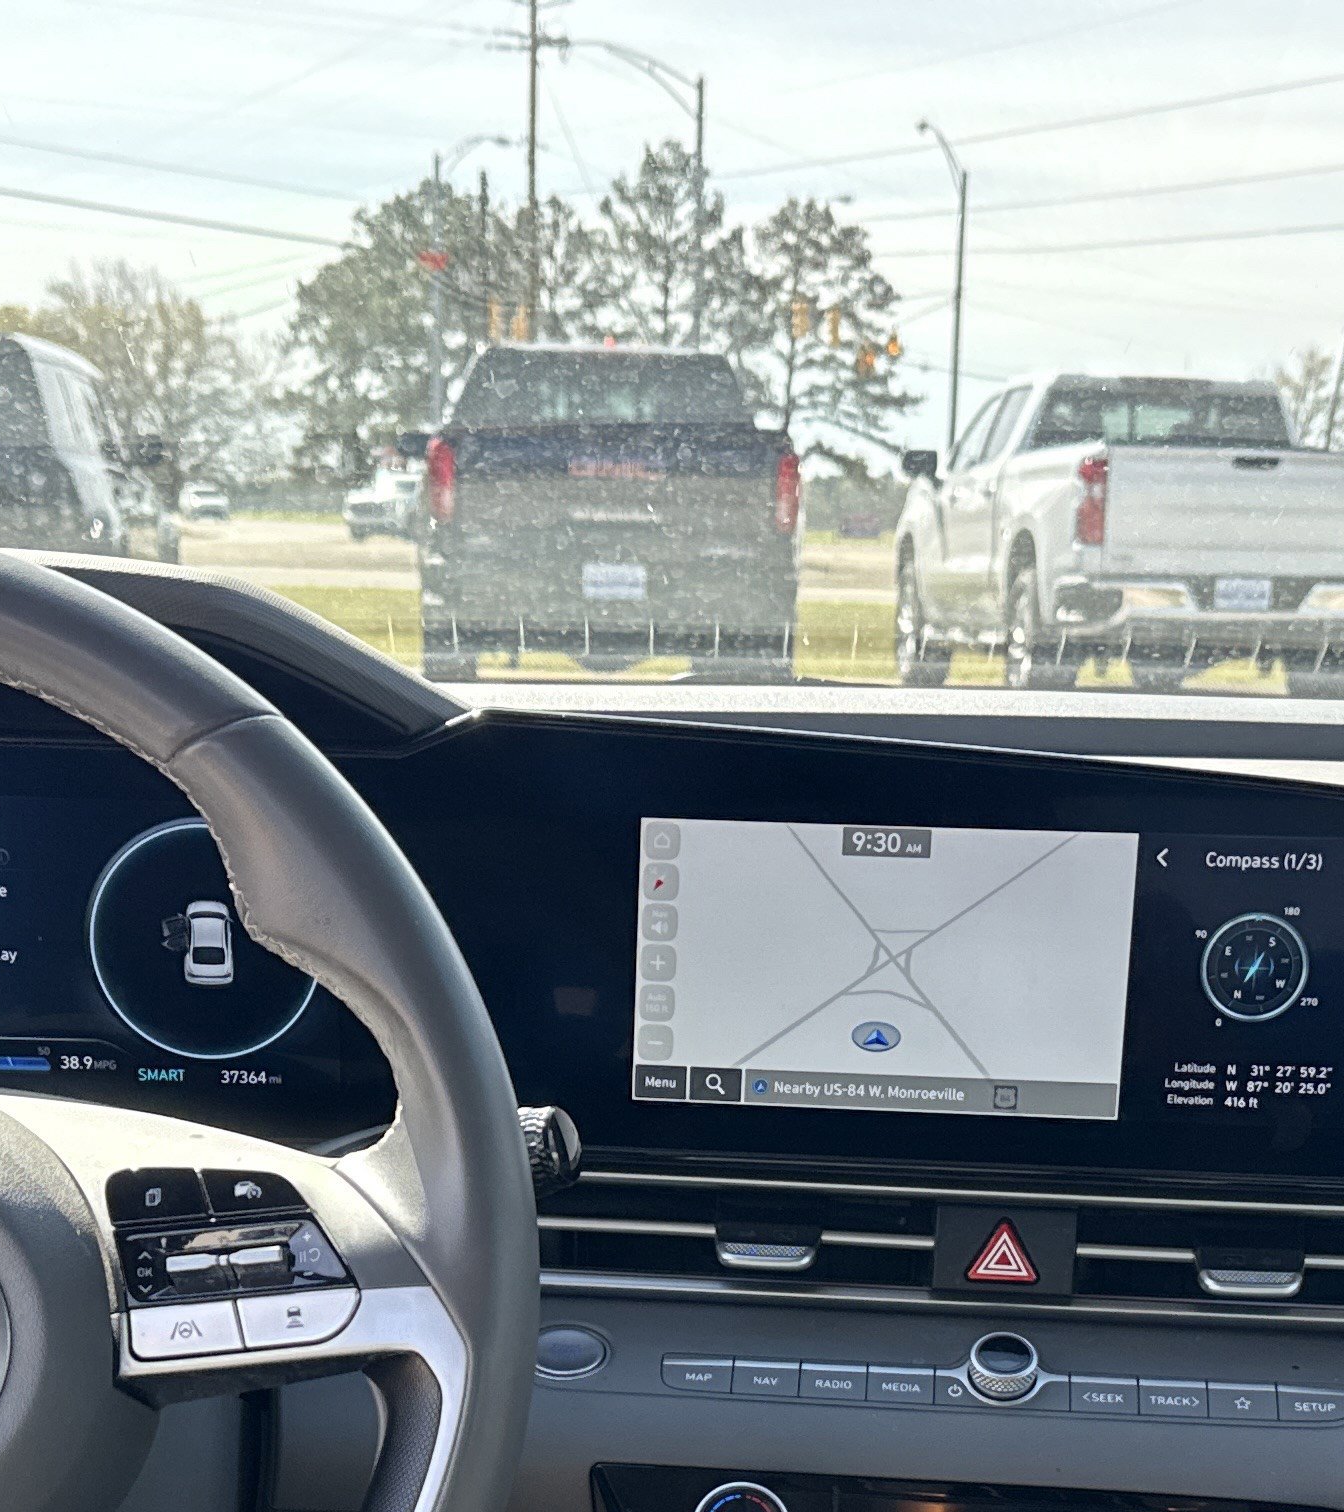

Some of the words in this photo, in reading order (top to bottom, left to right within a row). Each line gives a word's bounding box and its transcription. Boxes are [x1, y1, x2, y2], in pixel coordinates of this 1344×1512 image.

[852, 831, 902, 853] 9:30
[906, 843, 922, 854] AM
[1206, 851, 1280, 871] Compass
[1284, 853, 1323, 871] (1/3)
[1284, 907, 1301, 916] 180
[1195, 929, 1208, 939] 90
[1268, 937, 1276, 947] S
[1224, 946, 1232, 956] E
[1275, 979, 1286, 989] W
[1300, 997, 1318, 1006] 270
[1174, 1062, 1217, 1074] Latitude
[1226, 1064, 1237, 1076] N
[137, 1068, 186, 1083] SMART
[644, 1075, 677, 1089] Menu
[1164, 1078, 1215, 1091] Longitude
[1225, 1080, 1238, 1091] W
[773, 1080, 821, 1098] Nearby
[824, 1084, 865, 1097] US-84
[888, 1086, 965, 1101] Monroeville
[1167, 1094, 1214, 1105] Elevation
[1223, 1096, 1246, 1108] 416
[1248, 1097, 1258, 1108] ft
[136, 1266, 153, 1279] OK
[685, 1372, 712, 1382] MAP
[753, 1375, 779, 1387] NAV
[814, 1379, 853, 1390] RADIO
[881, 1382, 921, 1393] MEDIA
[1294, 1401, 1336, 1412] SETUP
